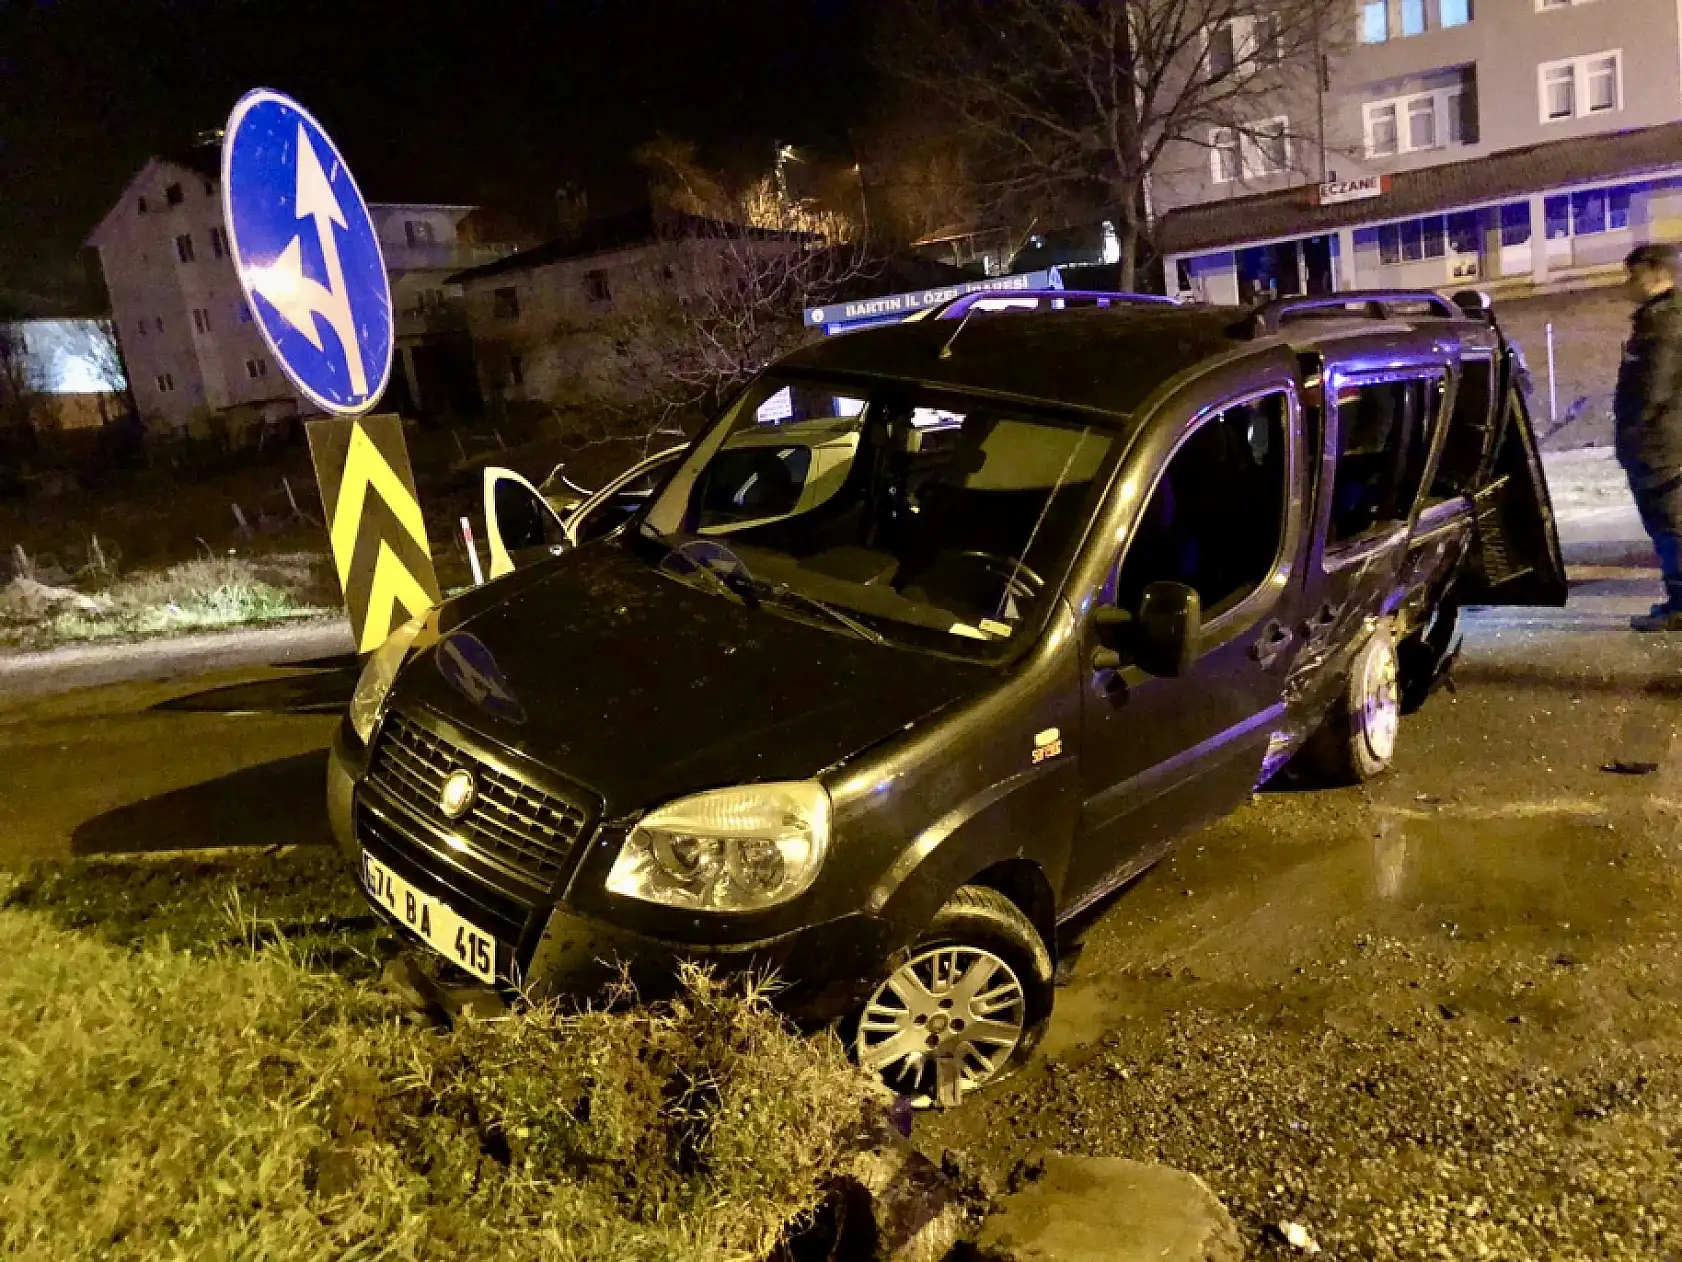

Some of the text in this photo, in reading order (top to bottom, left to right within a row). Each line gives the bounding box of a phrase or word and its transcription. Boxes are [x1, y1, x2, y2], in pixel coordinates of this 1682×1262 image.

[1320, 176, 1378, 197] ECZANE
[846, 298, 900, 317] BARTIN
[923, 287, 957, 304] ÖZEL
[375, 866, 490, 974] 74 BA 415
